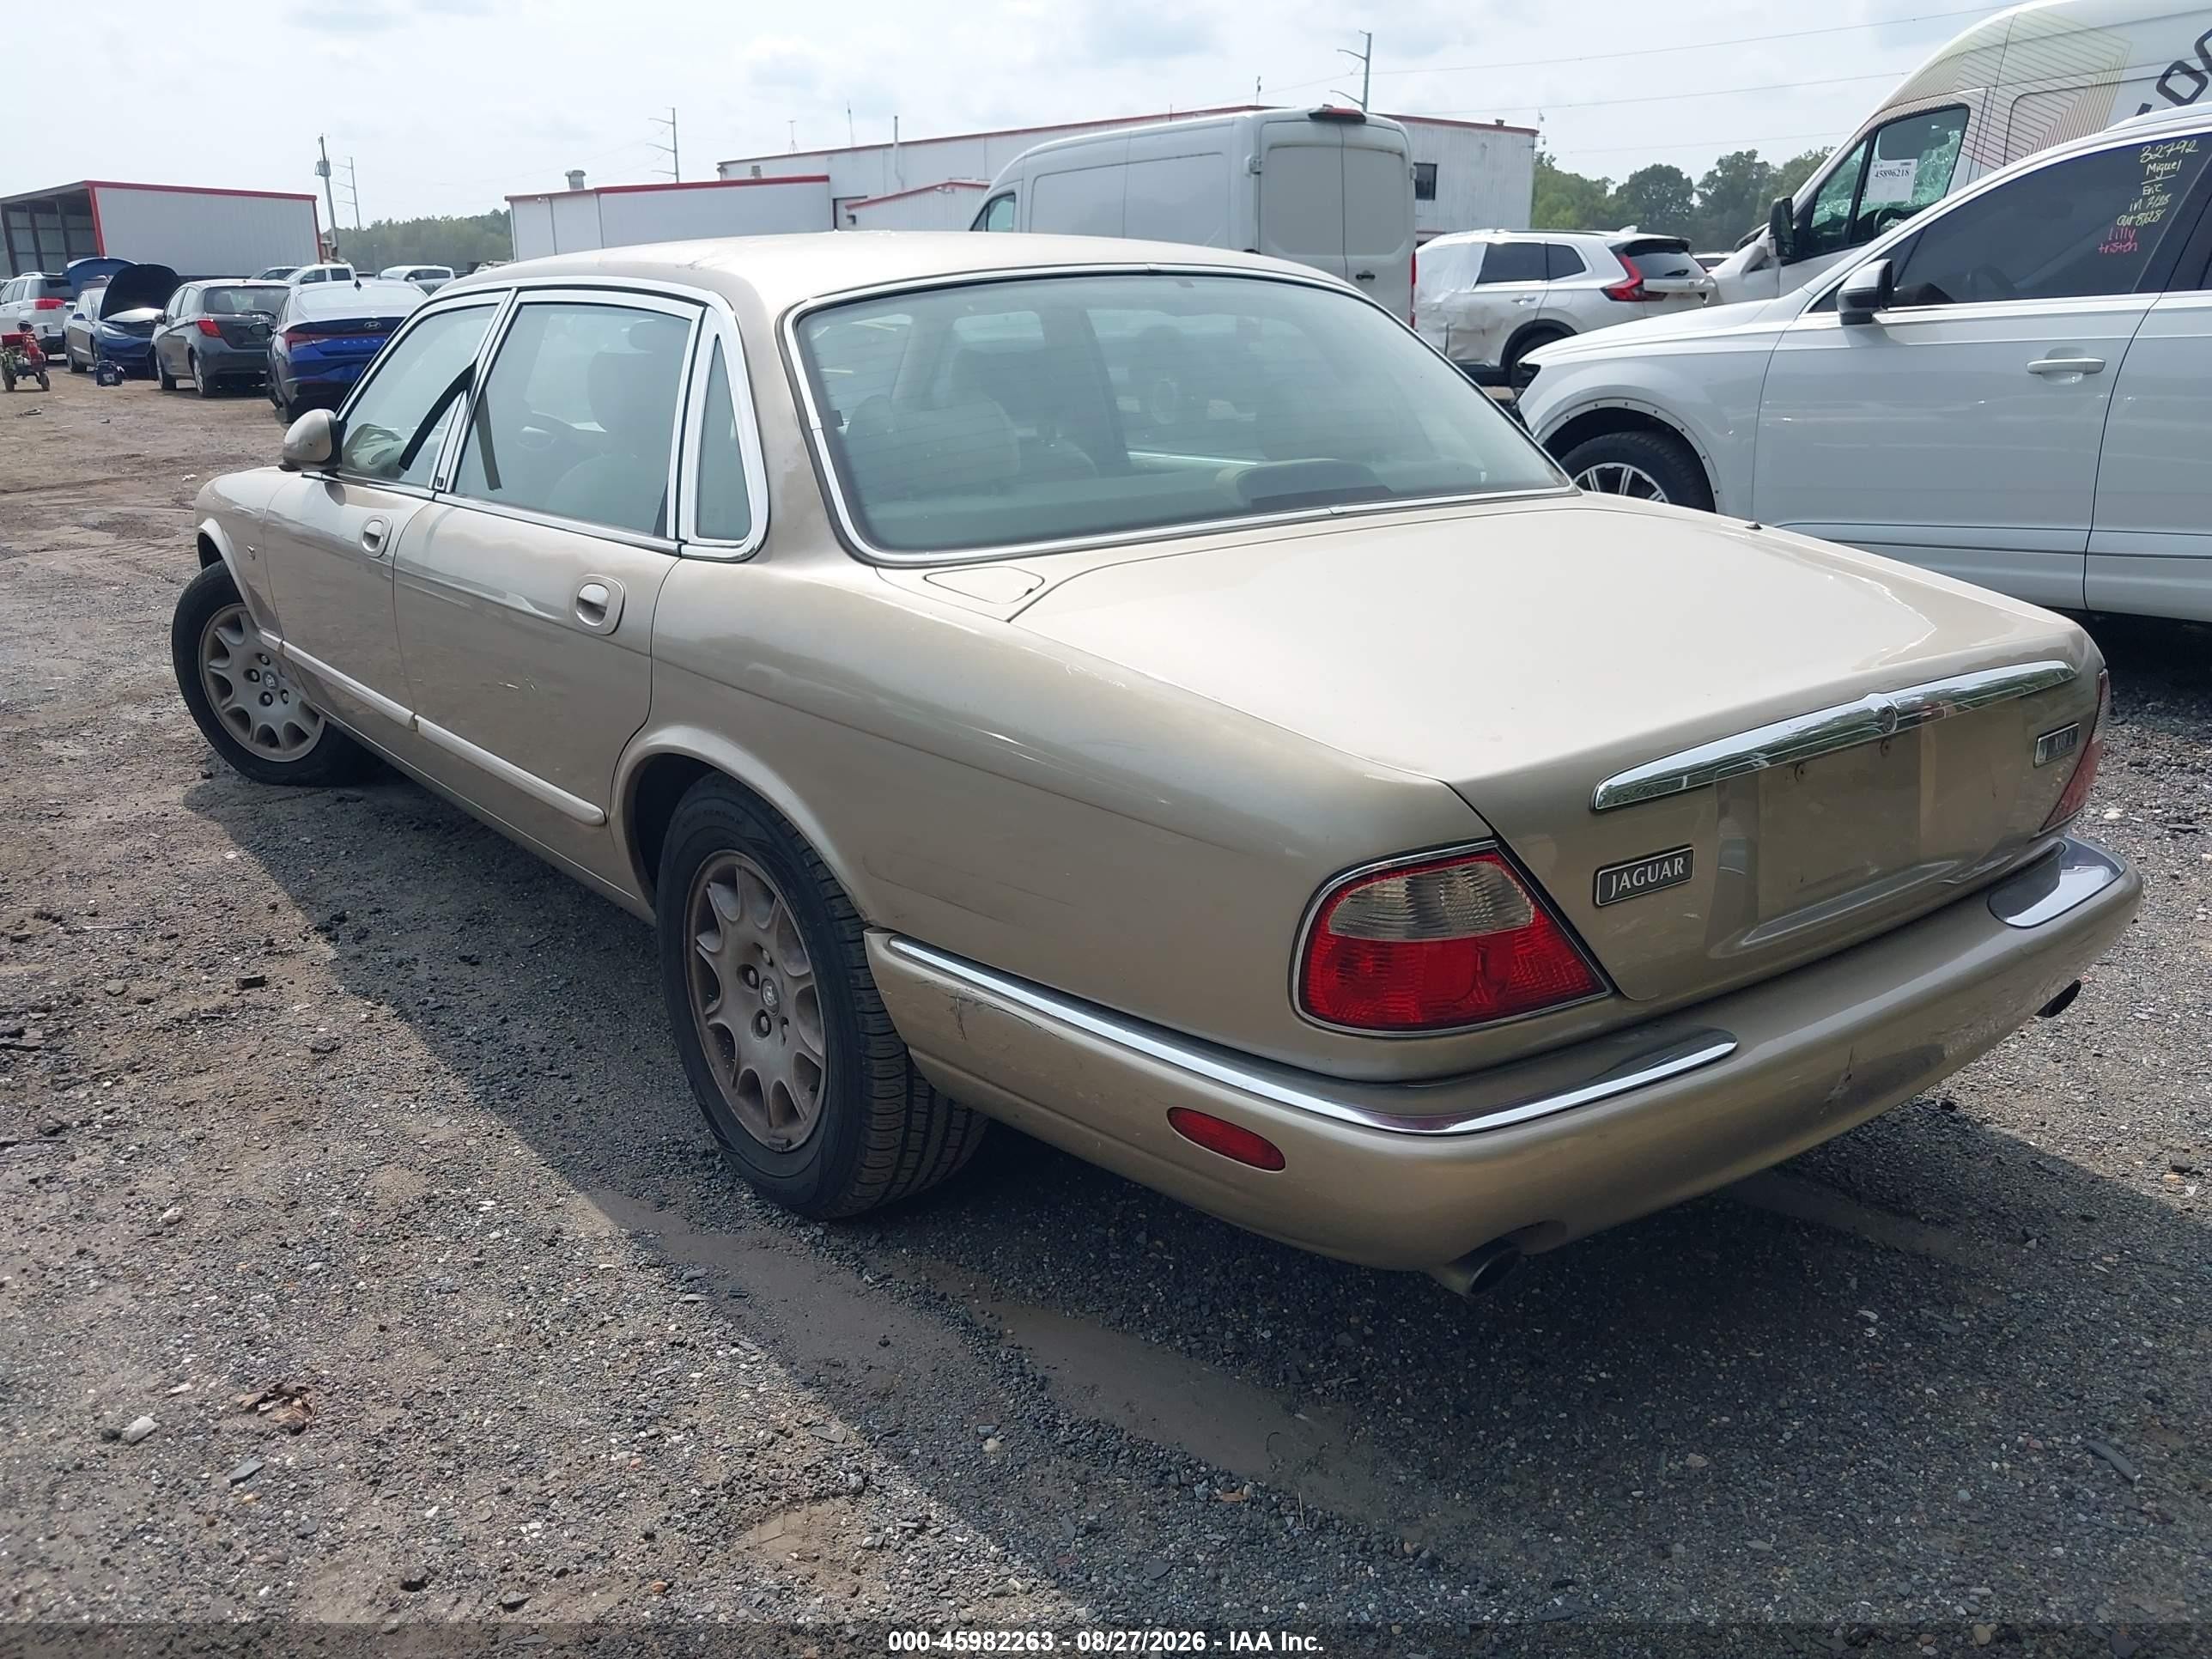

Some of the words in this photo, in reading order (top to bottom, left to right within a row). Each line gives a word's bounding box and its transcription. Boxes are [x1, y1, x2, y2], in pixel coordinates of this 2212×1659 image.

[2140, 139, 2199, 163] 32792
[2146, 160, 2182, 179] Miguel
[2142, 184, 2163, 196] Eric
[1609, 857, 1684, 899] JAGUAR
